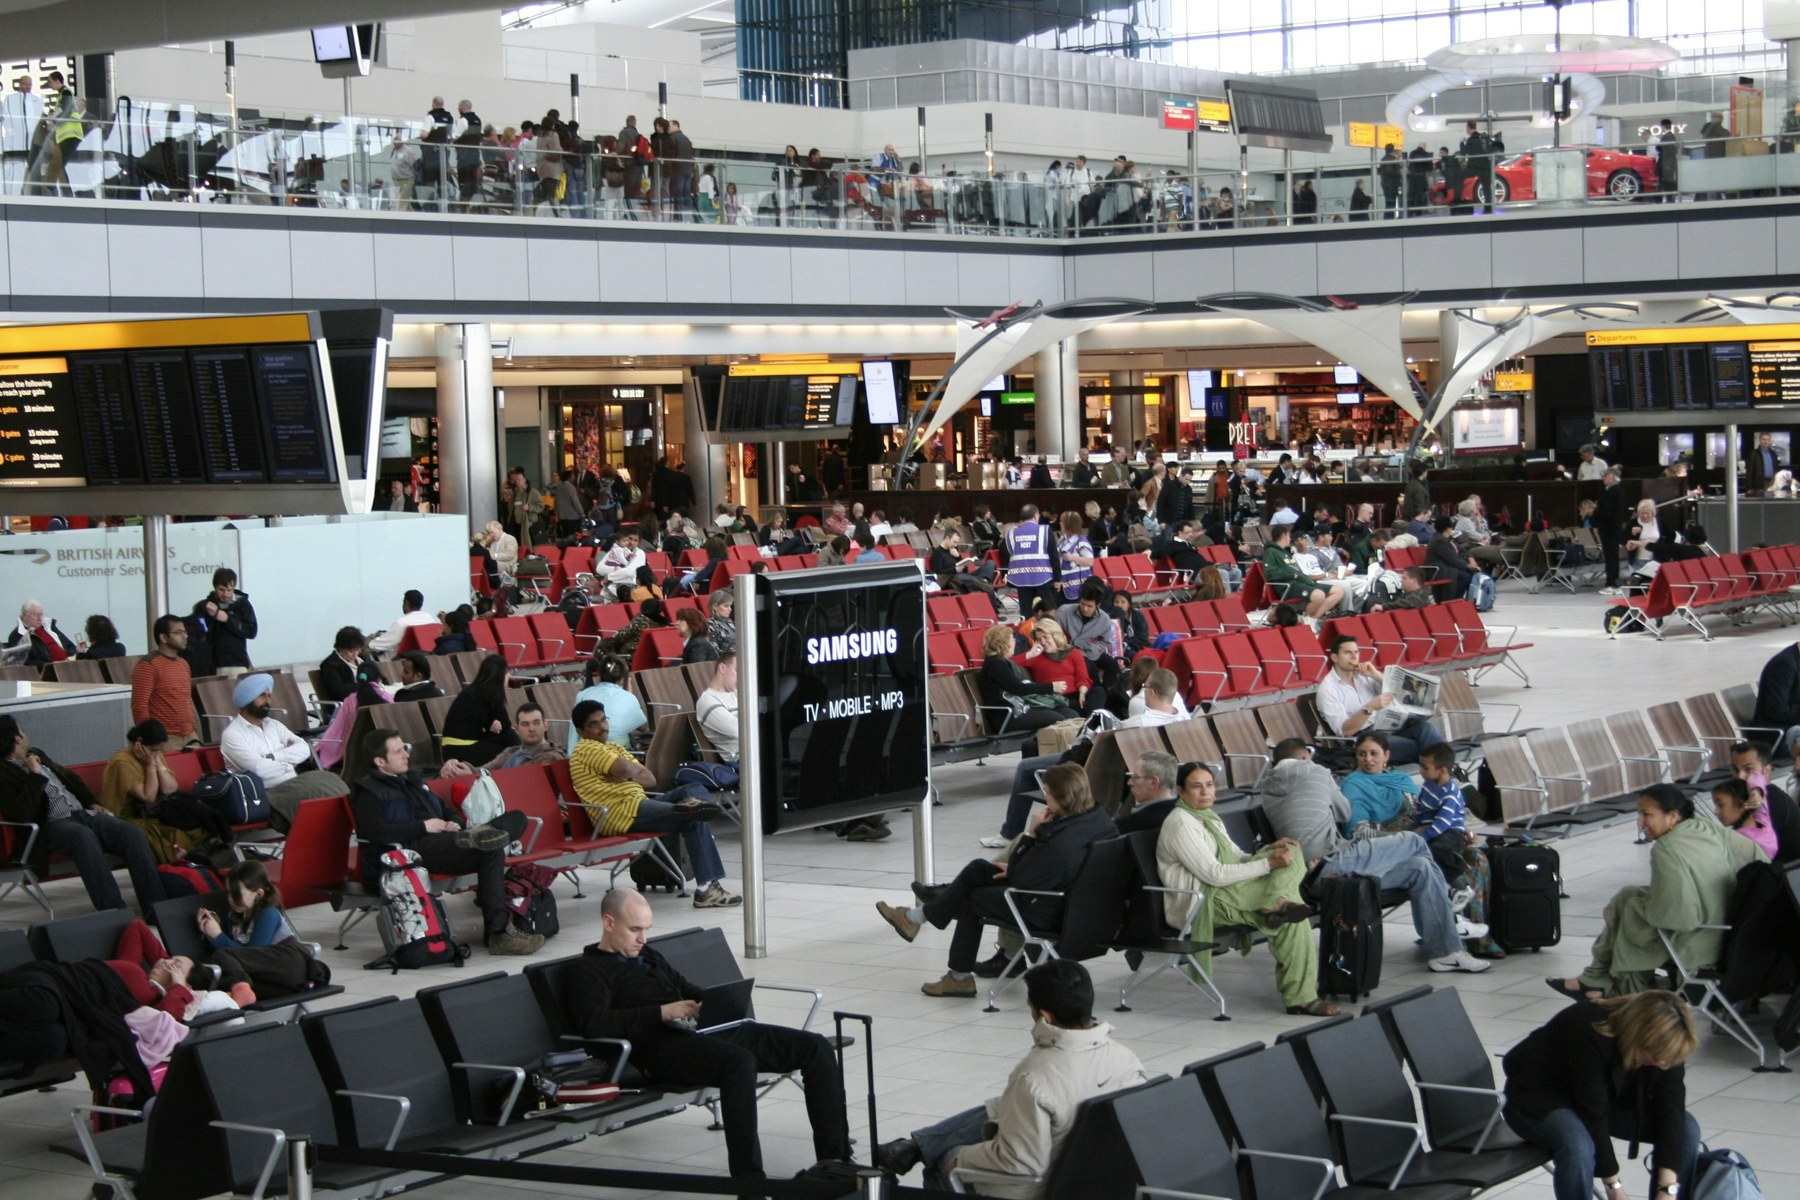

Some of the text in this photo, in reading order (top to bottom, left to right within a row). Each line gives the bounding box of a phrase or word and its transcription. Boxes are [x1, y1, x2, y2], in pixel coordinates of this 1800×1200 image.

[25, 380, 52, 388] following
[32, 389, 45, 397] gate
[6, 430, 21, 438] gates
[1229, 422, 1257, 445] PRET
[57, 548, 112, 561] BRITISH
[57, 565, 116, 577] Customer
[807, 629, 897, 664] SAMSUNG
[803, 690, 904, 722] TV MOBILE MP3
